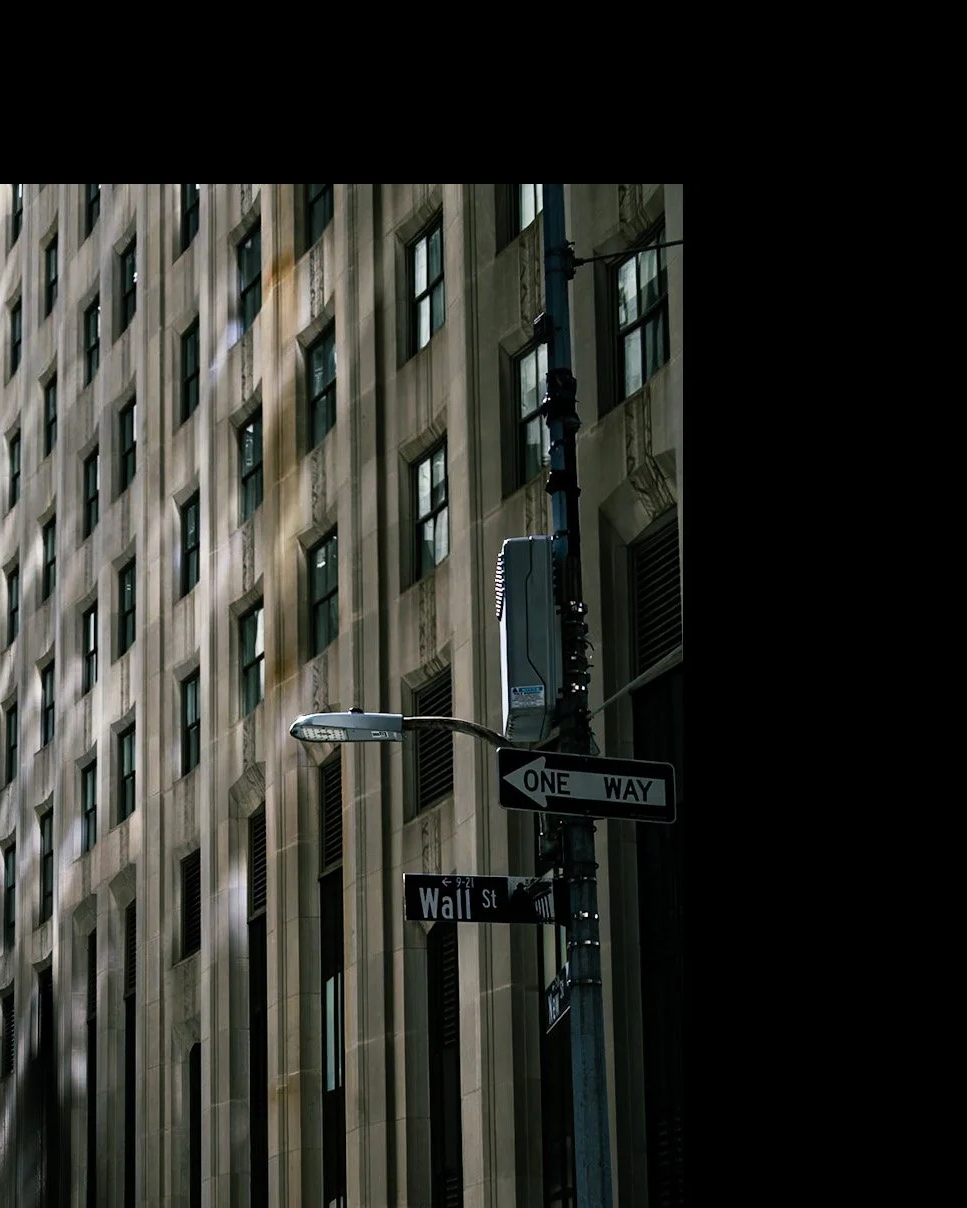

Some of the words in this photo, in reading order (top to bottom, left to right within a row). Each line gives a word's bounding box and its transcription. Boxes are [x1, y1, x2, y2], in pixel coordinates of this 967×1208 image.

[523, 769, 571, 796] ONE
[603, 776, 653, 802] WAY
[456, 877, 474, 889] 9-21
[419, 887, 471, 920] Wall
[482, 888, 498, 909] St
